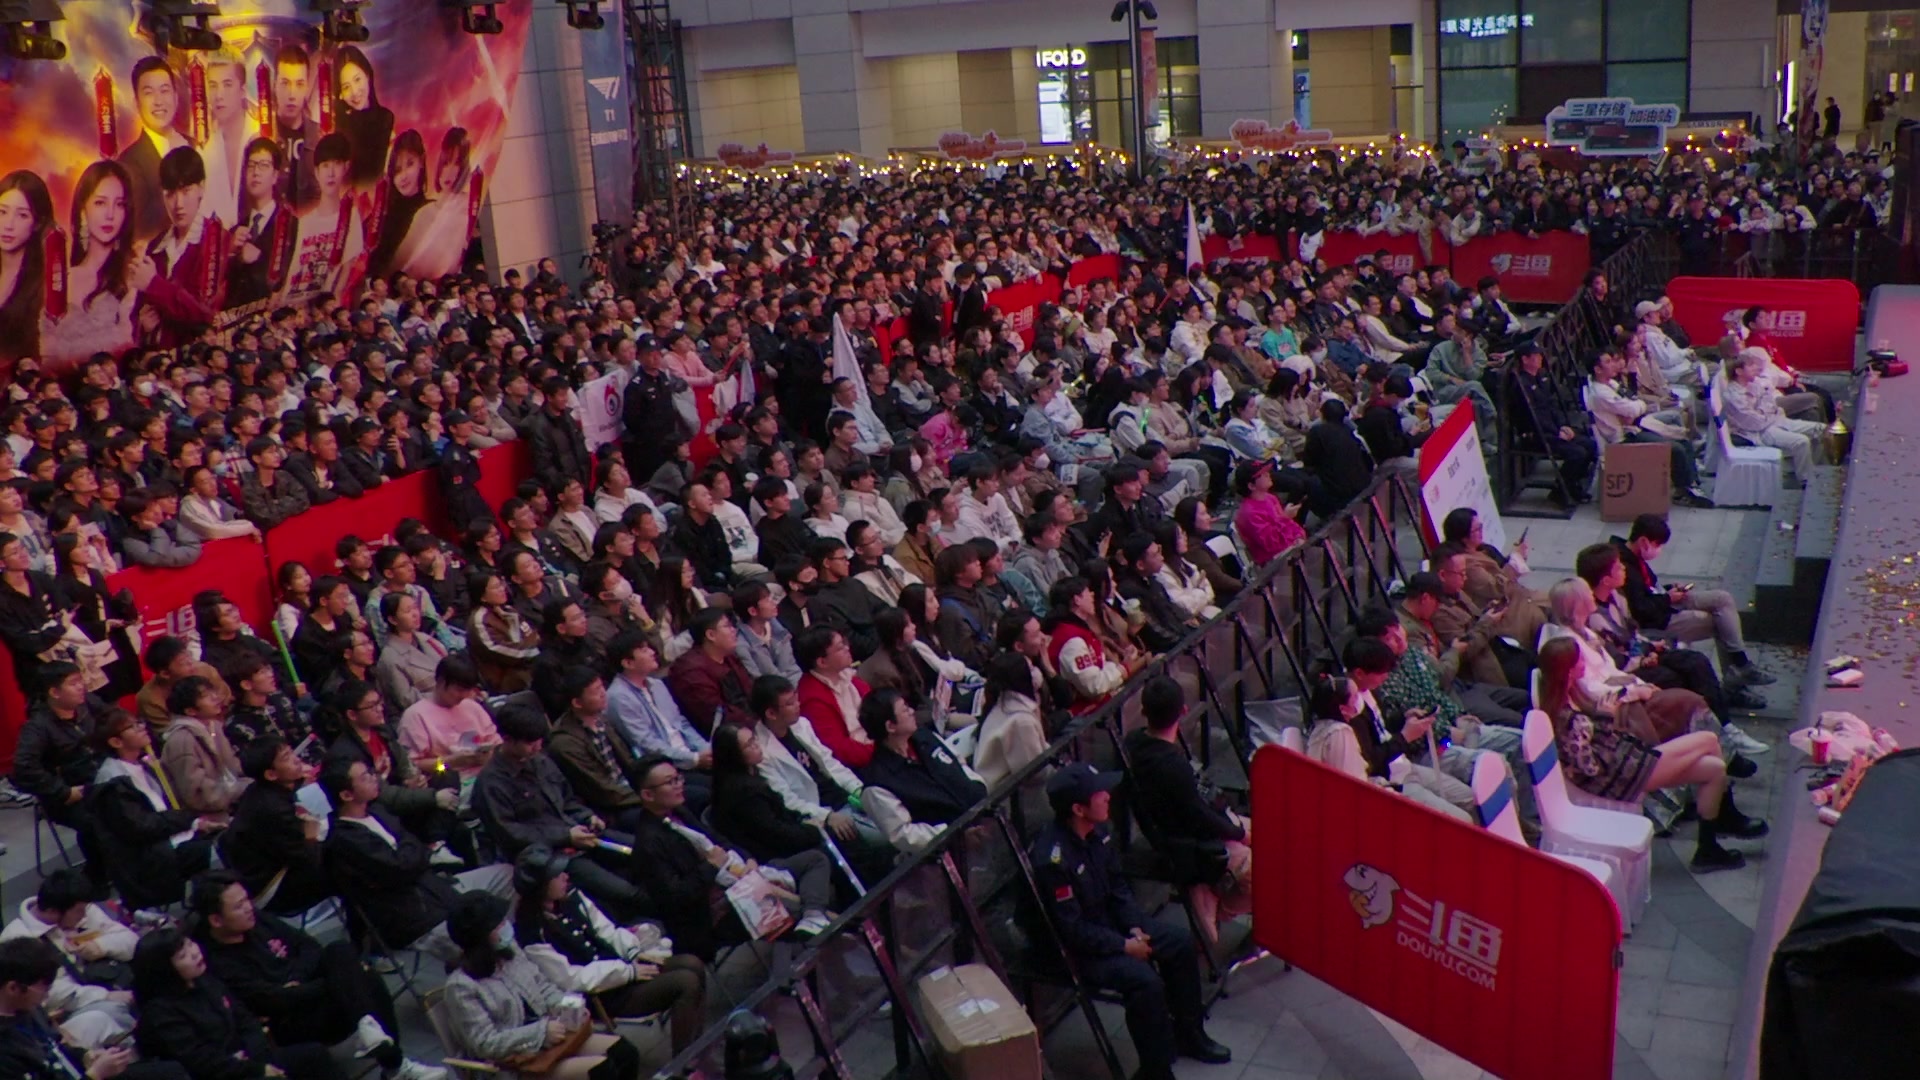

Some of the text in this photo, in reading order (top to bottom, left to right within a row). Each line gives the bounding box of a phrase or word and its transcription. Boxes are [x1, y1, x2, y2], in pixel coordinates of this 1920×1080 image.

[1571, 103, 1626, 116] 三星存储
[1628, 110, 1674, 123] 加油站
[1397, 931, 1496, 992] DOUYU.COM
